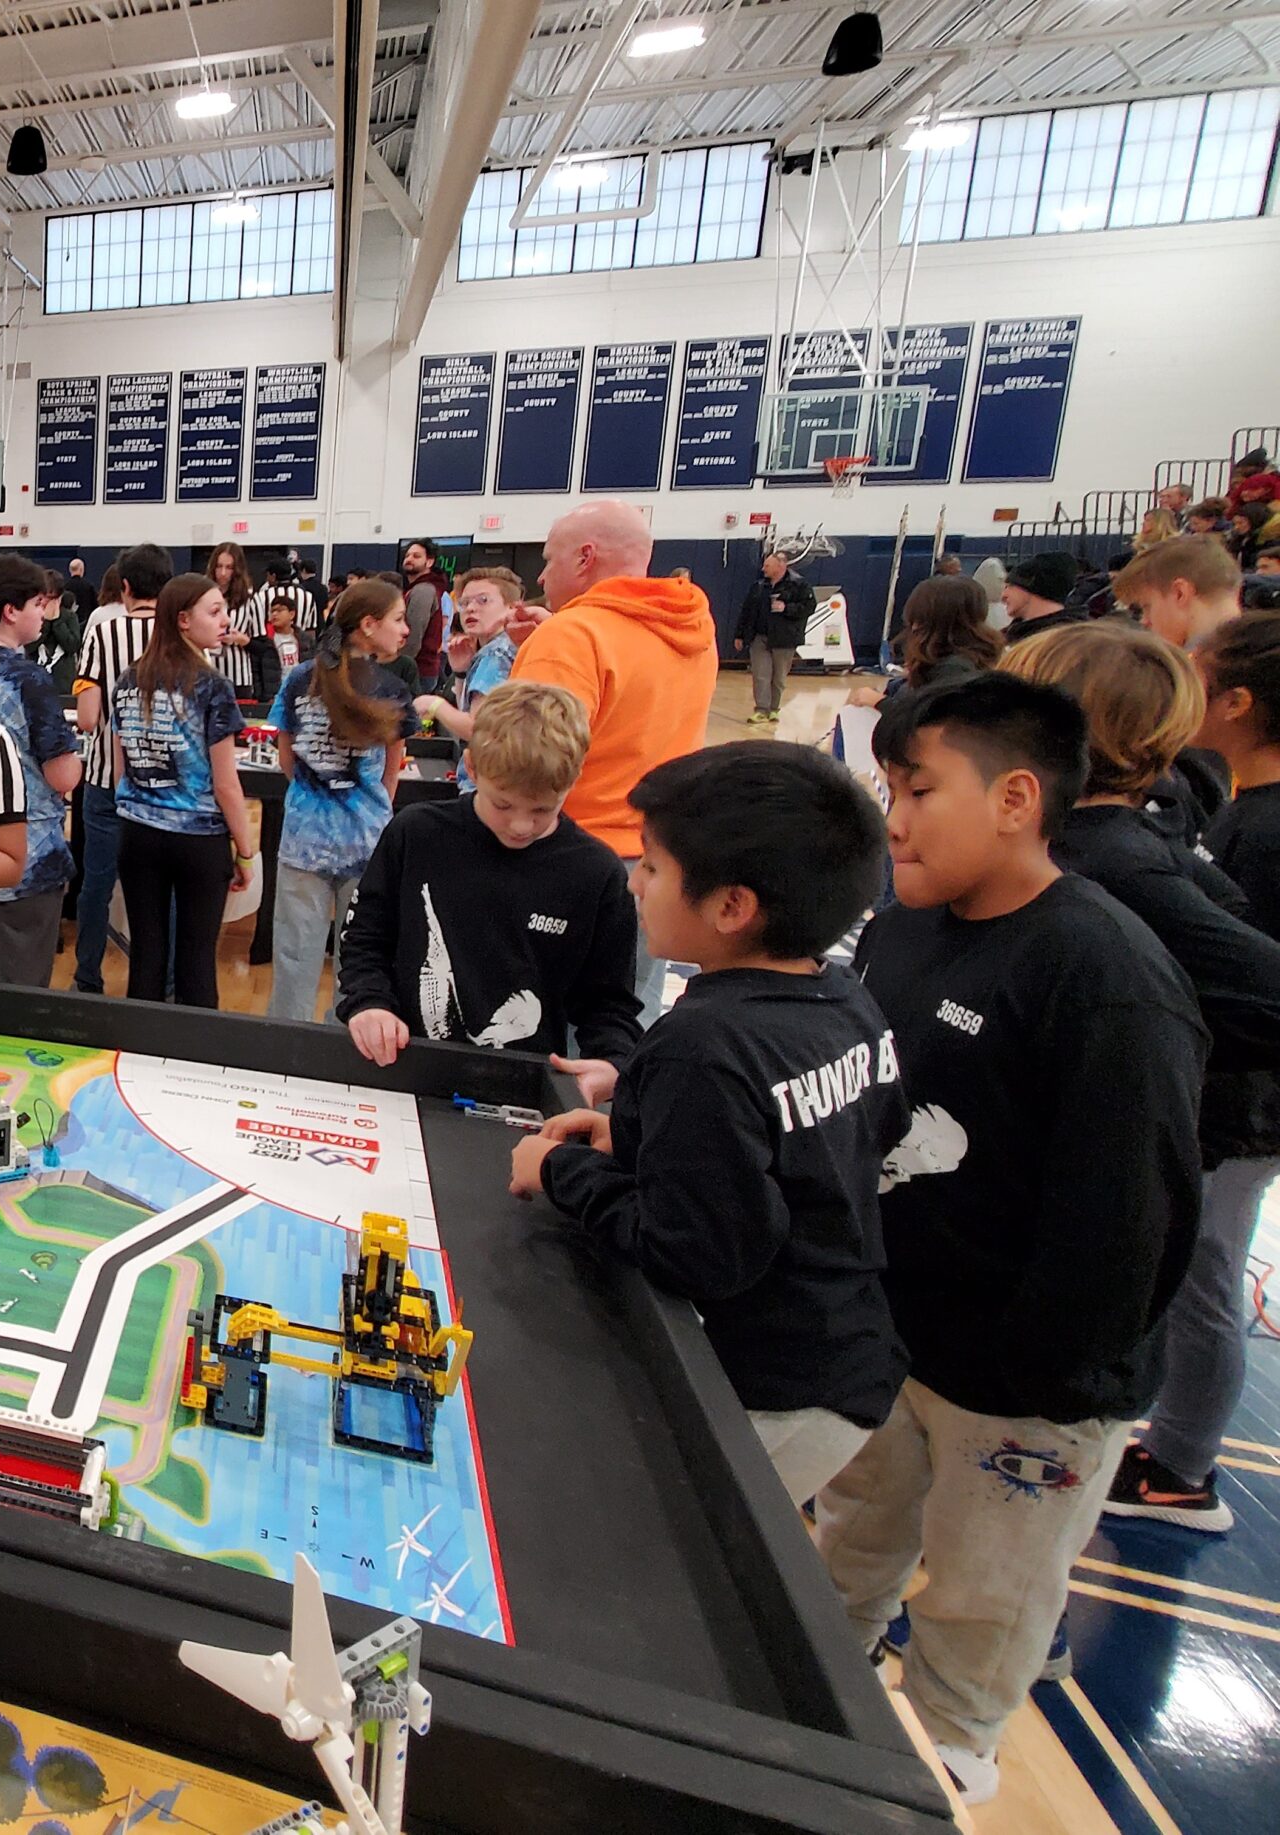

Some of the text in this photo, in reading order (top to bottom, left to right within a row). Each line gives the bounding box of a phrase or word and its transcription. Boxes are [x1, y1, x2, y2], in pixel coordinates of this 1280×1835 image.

[194, 371, 232, 380] FOOTBALL
[528, 913, 568, 935] 36659
[936, 998, 984, 1035] 36659
[231, 1084, 265, 1095] LEGO
[771, 1042, 870, 1133] THUNDER
[276, 1105, 348, 1119] Automation
[291, 1111, 348, 1125] Rockwell
[236, 1131, 302, 1150] LEAGUE
[248, 1122, 367, 1148] CHALLENGE
[249, 1149, 300, 1162] FIRST
[256, 1142, 302, 1156] LEGO
[311, 1505, 319, 1515] S
[260, 1529, 268, 1539] E
[360, 1557, 375, 1570] W
